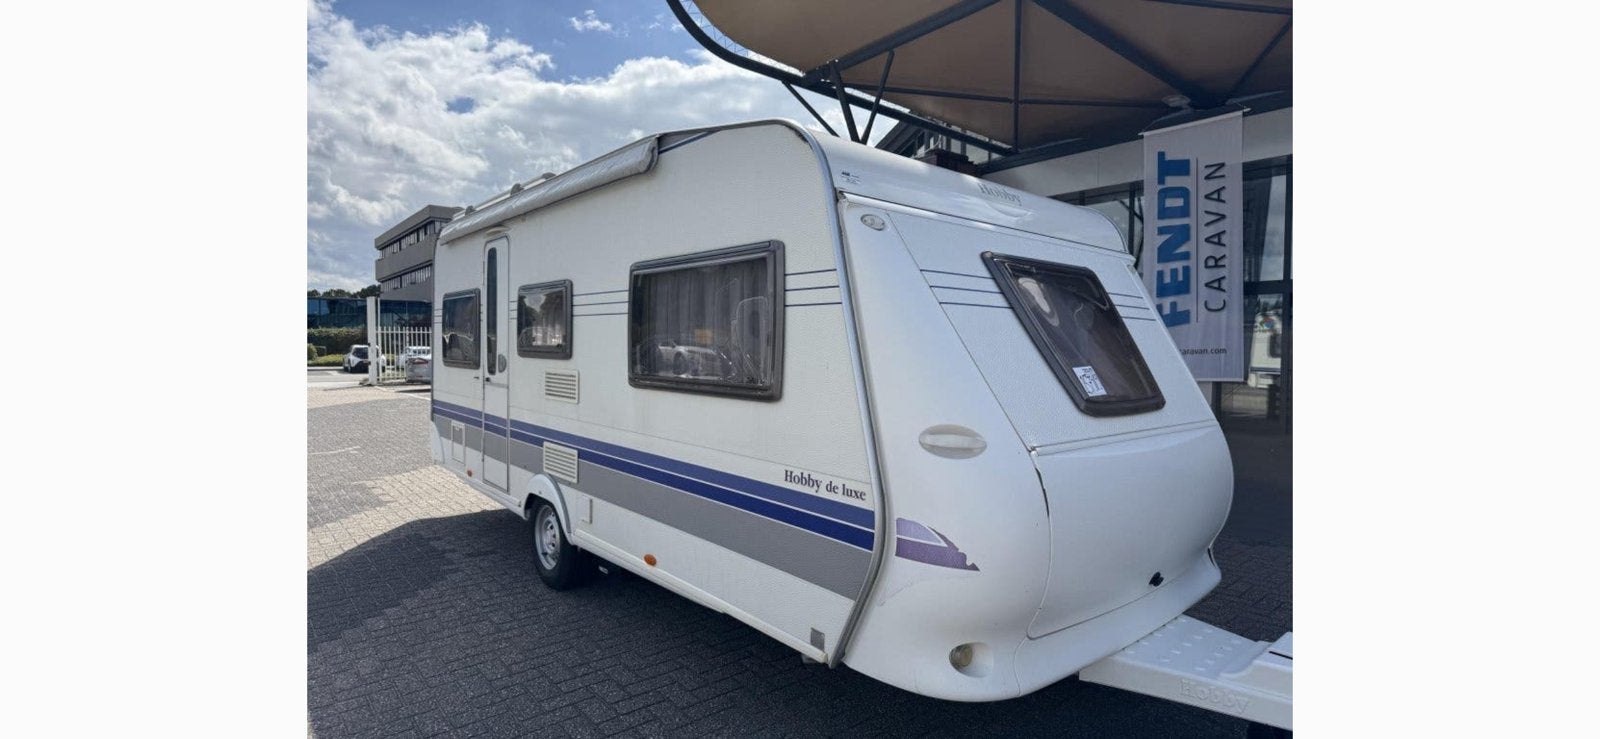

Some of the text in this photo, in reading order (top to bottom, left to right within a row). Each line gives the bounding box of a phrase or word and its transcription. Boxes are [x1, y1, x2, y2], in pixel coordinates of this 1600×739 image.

[977, 182, 1023, 207] Hobby
[1156, 151, 1191, 327] FENDT
[1204, 162, 1227, 313] CARAVAN
[1179, 347, 1227, 356] aravan.com
[784, 470, 867, 501] Hobby de luxe
[1180, 680, 1250, 714] Hobby
